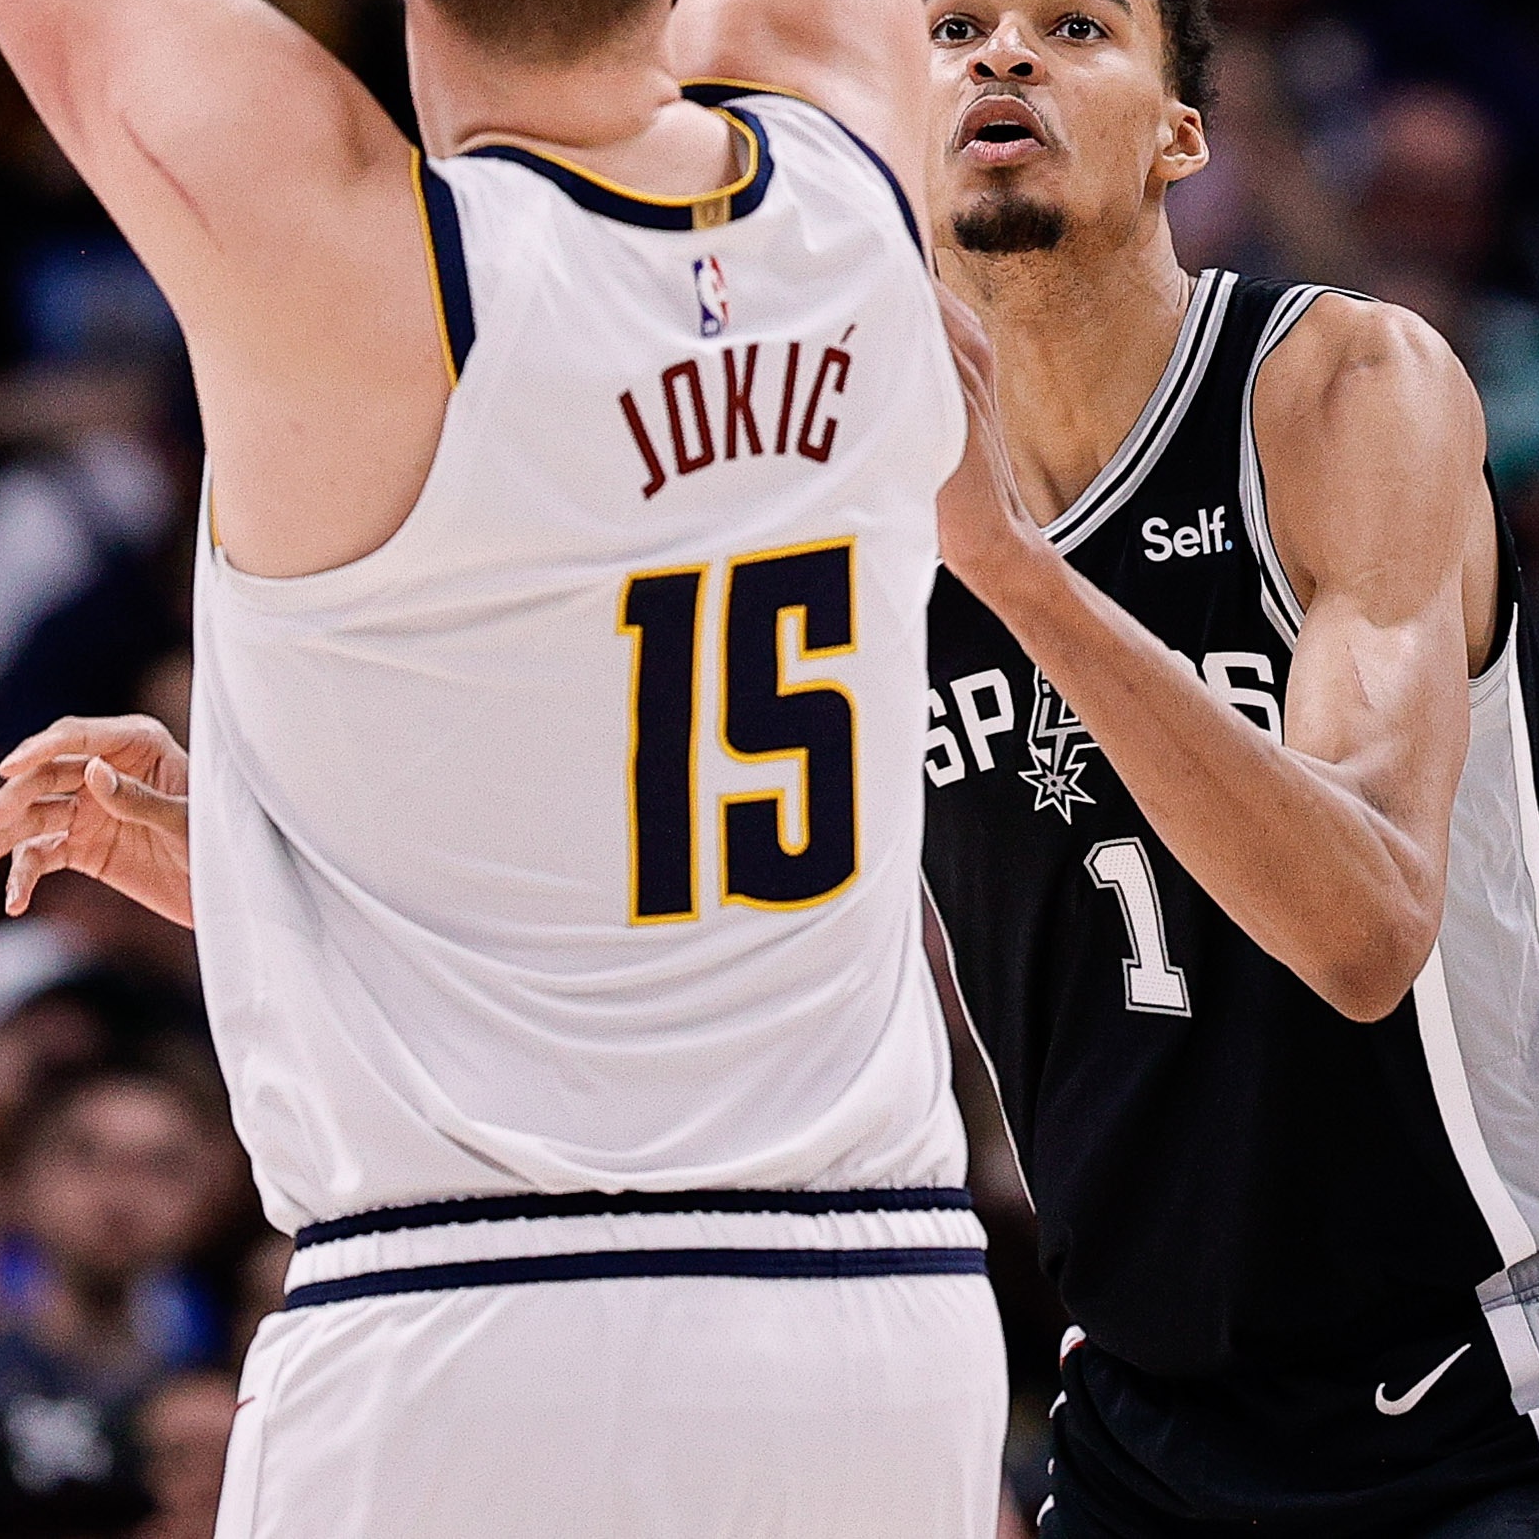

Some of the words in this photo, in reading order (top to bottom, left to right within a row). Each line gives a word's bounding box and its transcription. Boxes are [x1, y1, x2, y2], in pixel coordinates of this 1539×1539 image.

[619, 325, 858, 500] JOKIĆ
[616, 535, 860, 925] 15
[924, 651, 1283, 823] SPS
[1083, 837, 1193, 1018] 1
